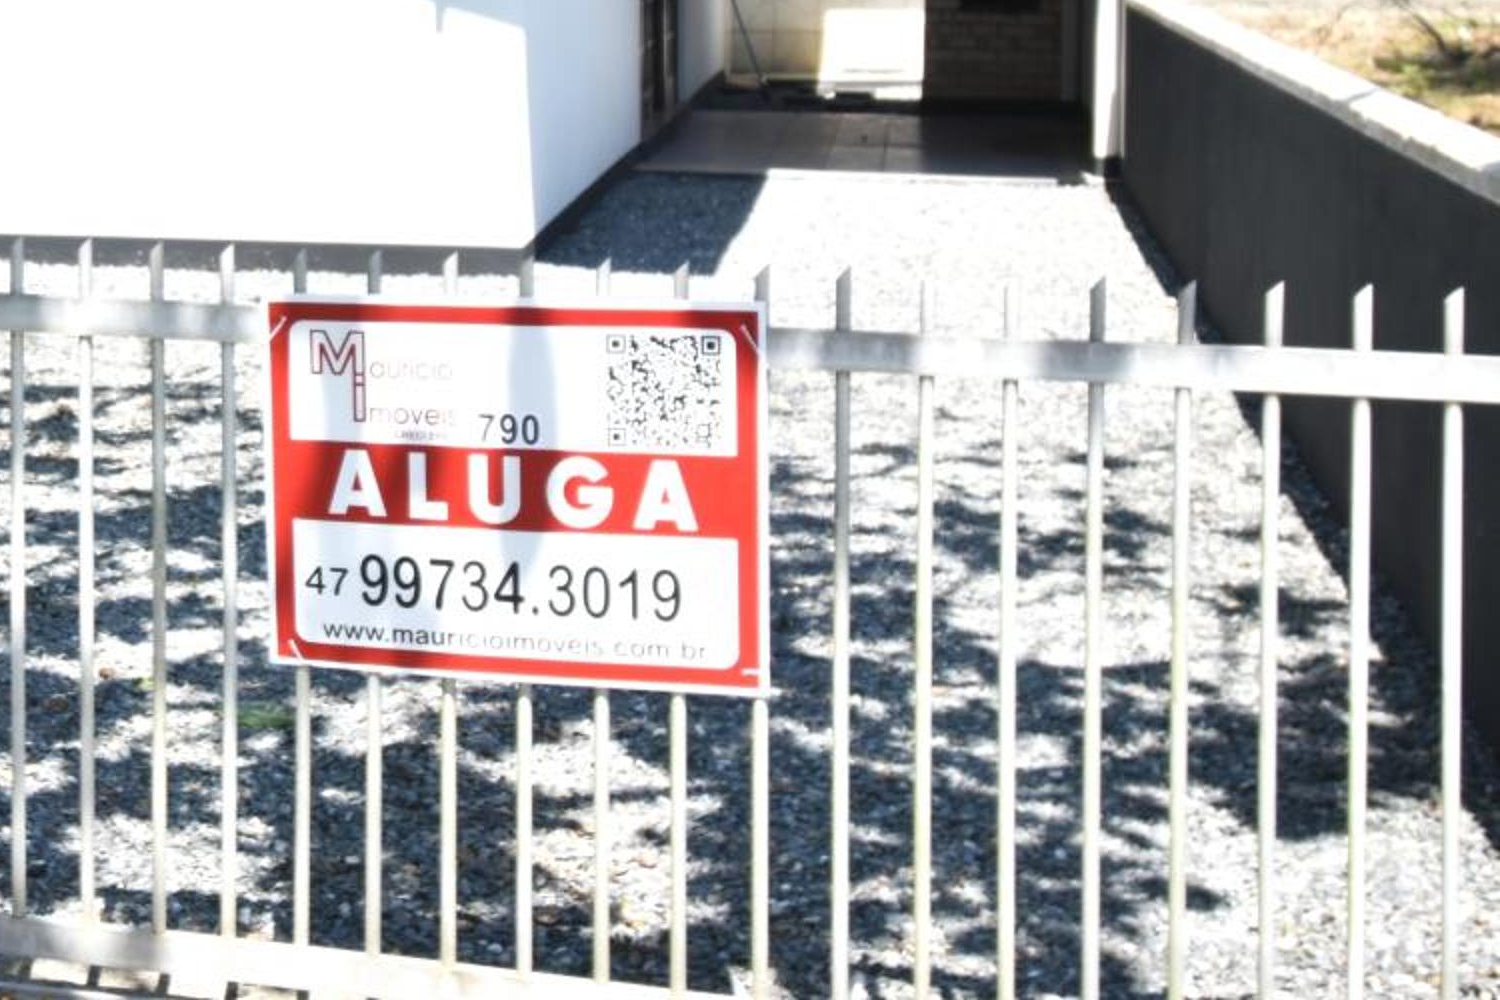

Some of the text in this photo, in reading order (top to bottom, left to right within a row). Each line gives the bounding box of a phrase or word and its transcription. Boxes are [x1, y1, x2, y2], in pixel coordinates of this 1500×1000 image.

[478, 413, 540, 445] 790
[328, 449, 698, 532] ALUGA
[304, 553, 681, 622] 47 99734.3019
[323, 622, 706, 661] www.mauricioimoveiscombr
